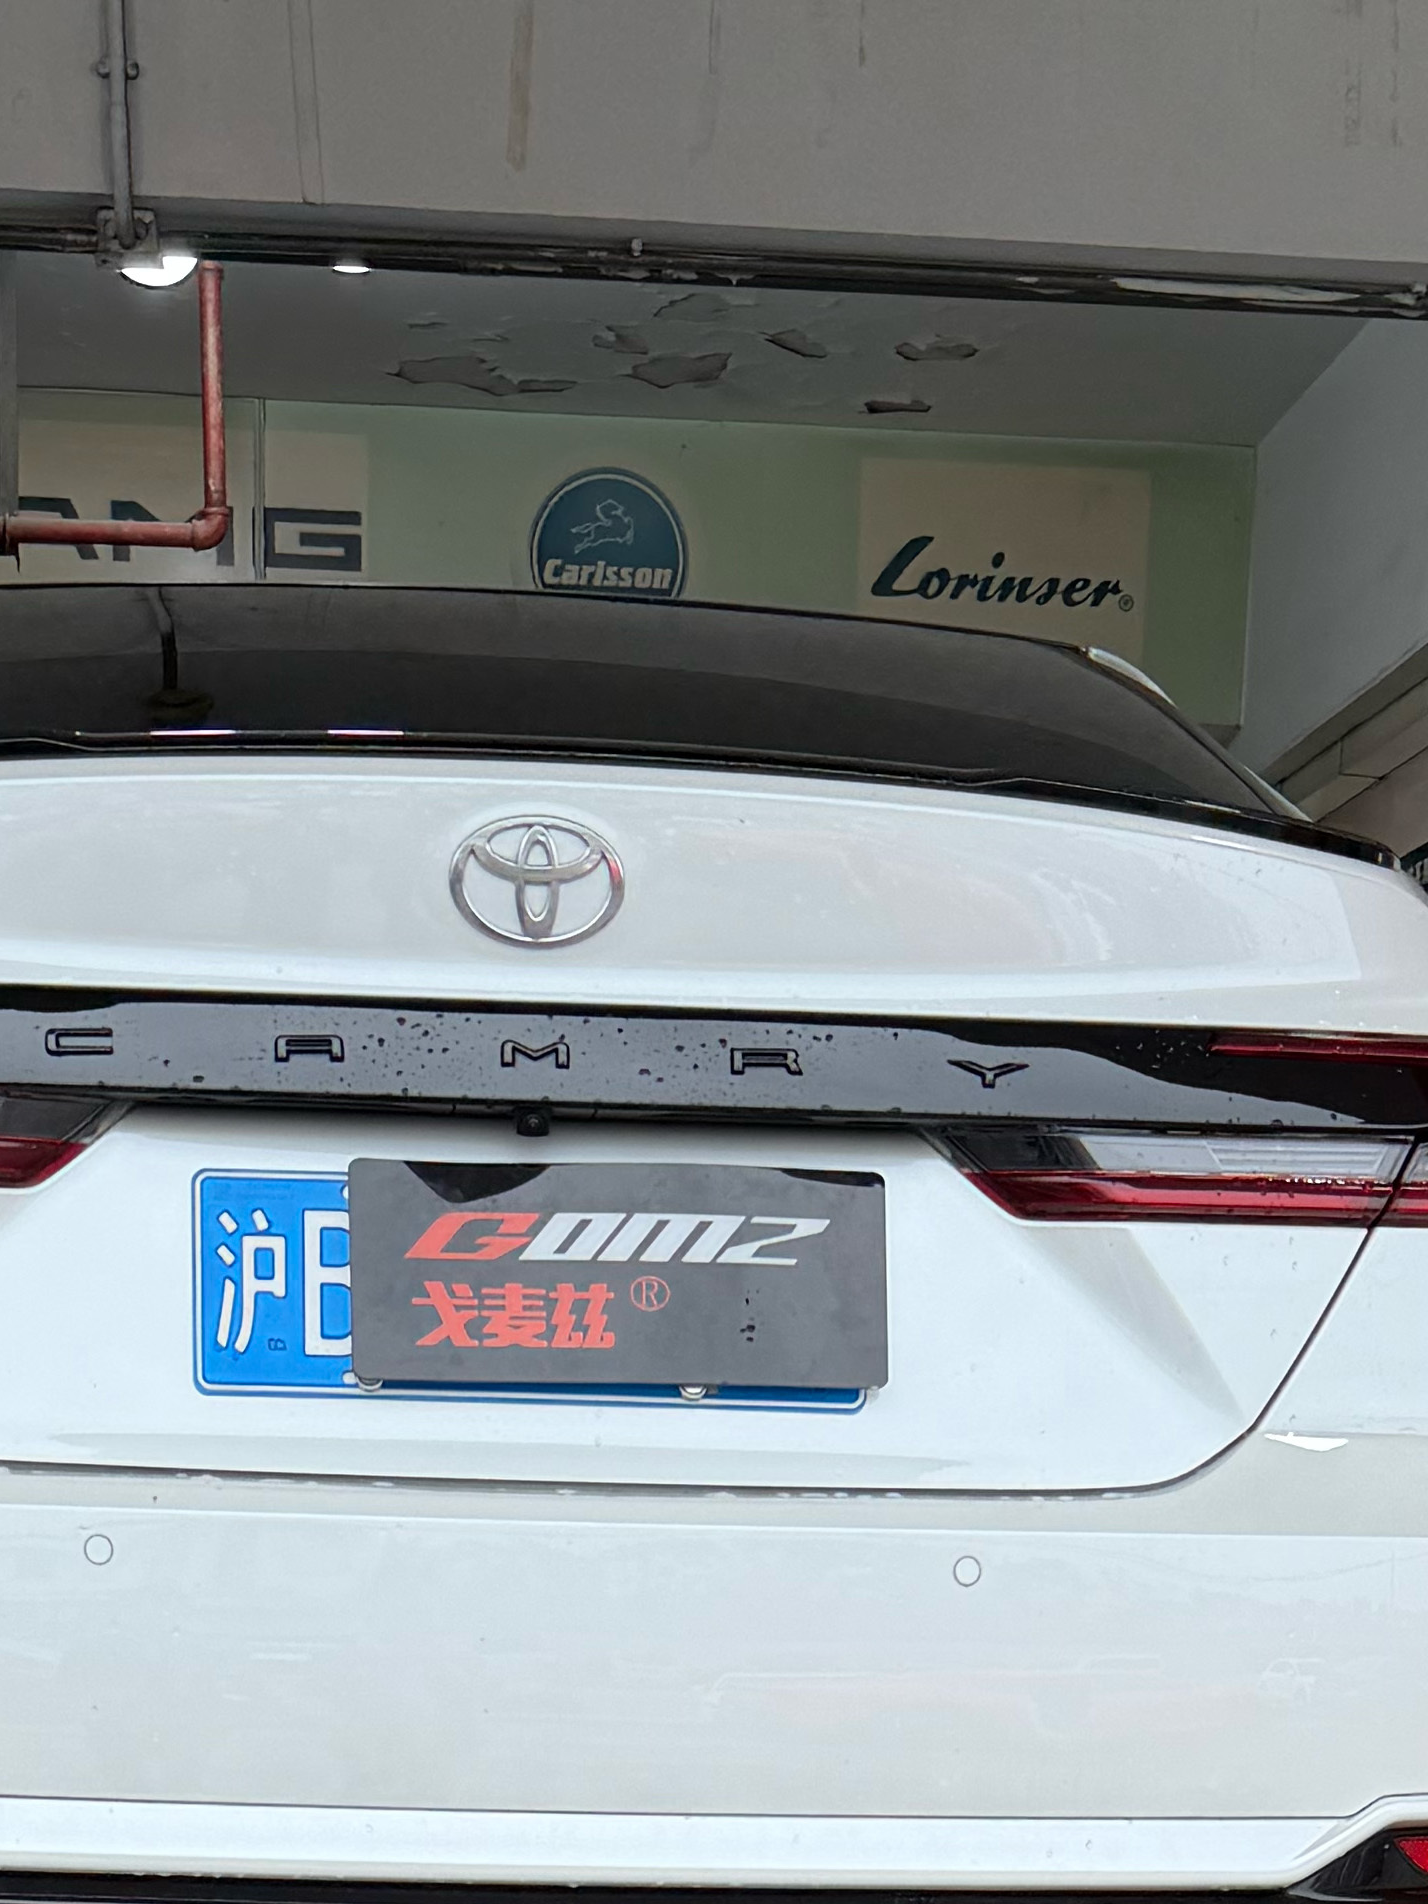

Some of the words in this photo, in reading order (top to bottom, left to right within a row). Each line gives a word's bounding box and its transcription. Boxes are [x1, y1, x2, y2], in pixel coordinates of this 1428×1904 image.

[542, 557, 673, 591] Carlsson
[872, 535, 1122, 608] Lorinser
[44, 1026, 1030, 1089] CAMRY
[404, 1211, 831, 1266] GOMZ
[411, 1280, 616, 1350] 戈麦兹
